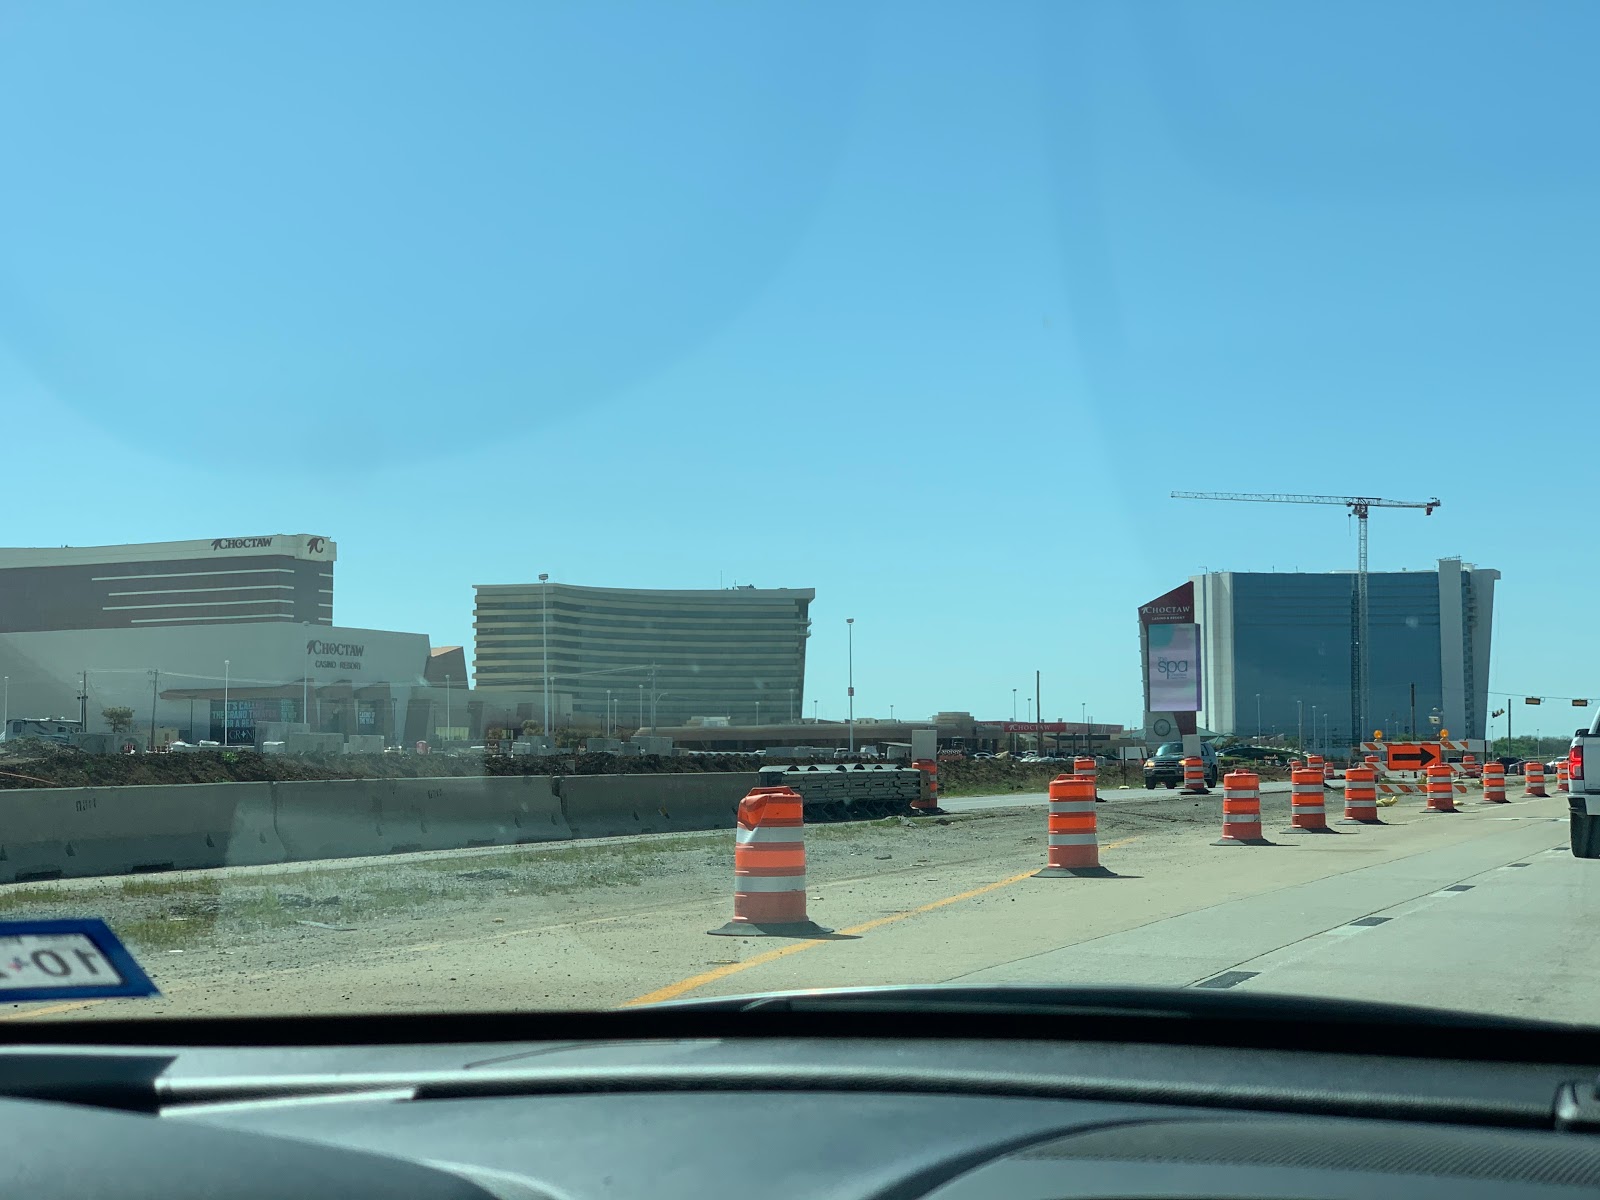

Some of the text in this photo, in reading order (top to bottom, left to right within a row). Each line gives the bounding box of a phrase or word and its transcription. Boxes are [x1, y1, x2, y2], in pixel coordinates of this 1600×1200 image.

[218, 537, 273, 550] CHOCTAW
[1145, 605, 1190, 614] CHOCTAW
[312, 639, 365, 657] CHOCTAW
[315, 660, 361, 670] CASINO RESORT
[1157, 660, 1188, 680] spa
